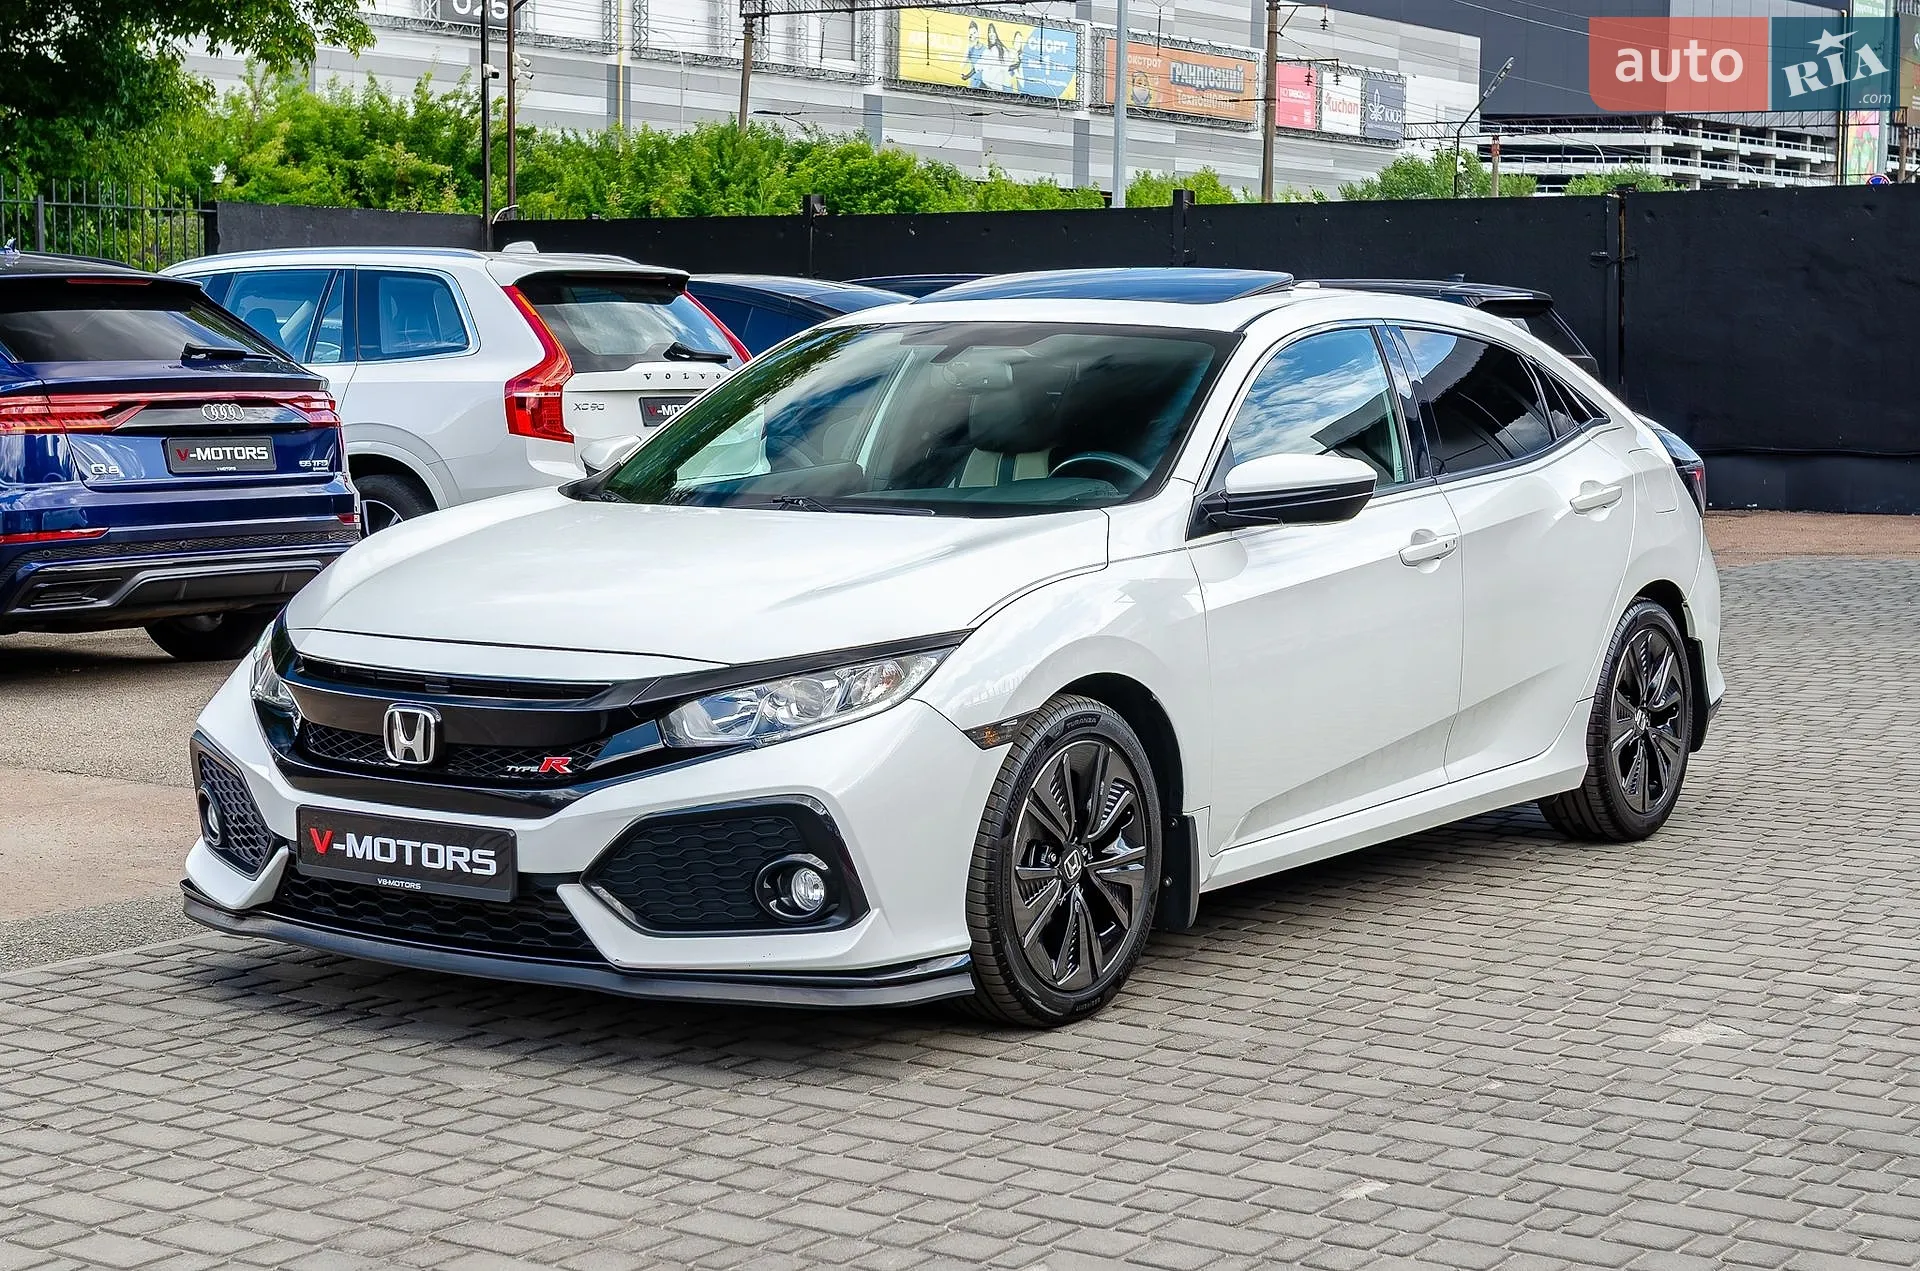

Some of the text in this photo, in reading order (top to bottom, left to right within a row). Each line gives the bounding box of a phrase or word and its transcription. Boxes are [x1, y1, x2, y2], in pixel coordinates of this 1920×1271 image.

[1127, 55, 1162, 69] окстрот
[643, 372, 721, 381] VOLVO
[176, 447, 269, 462] V-MOTORS
[91, 463, 119, 475] Q8
[506, 756, 573, 774] TYPE R
[309, 826, 498, 877] V-MOTORS
